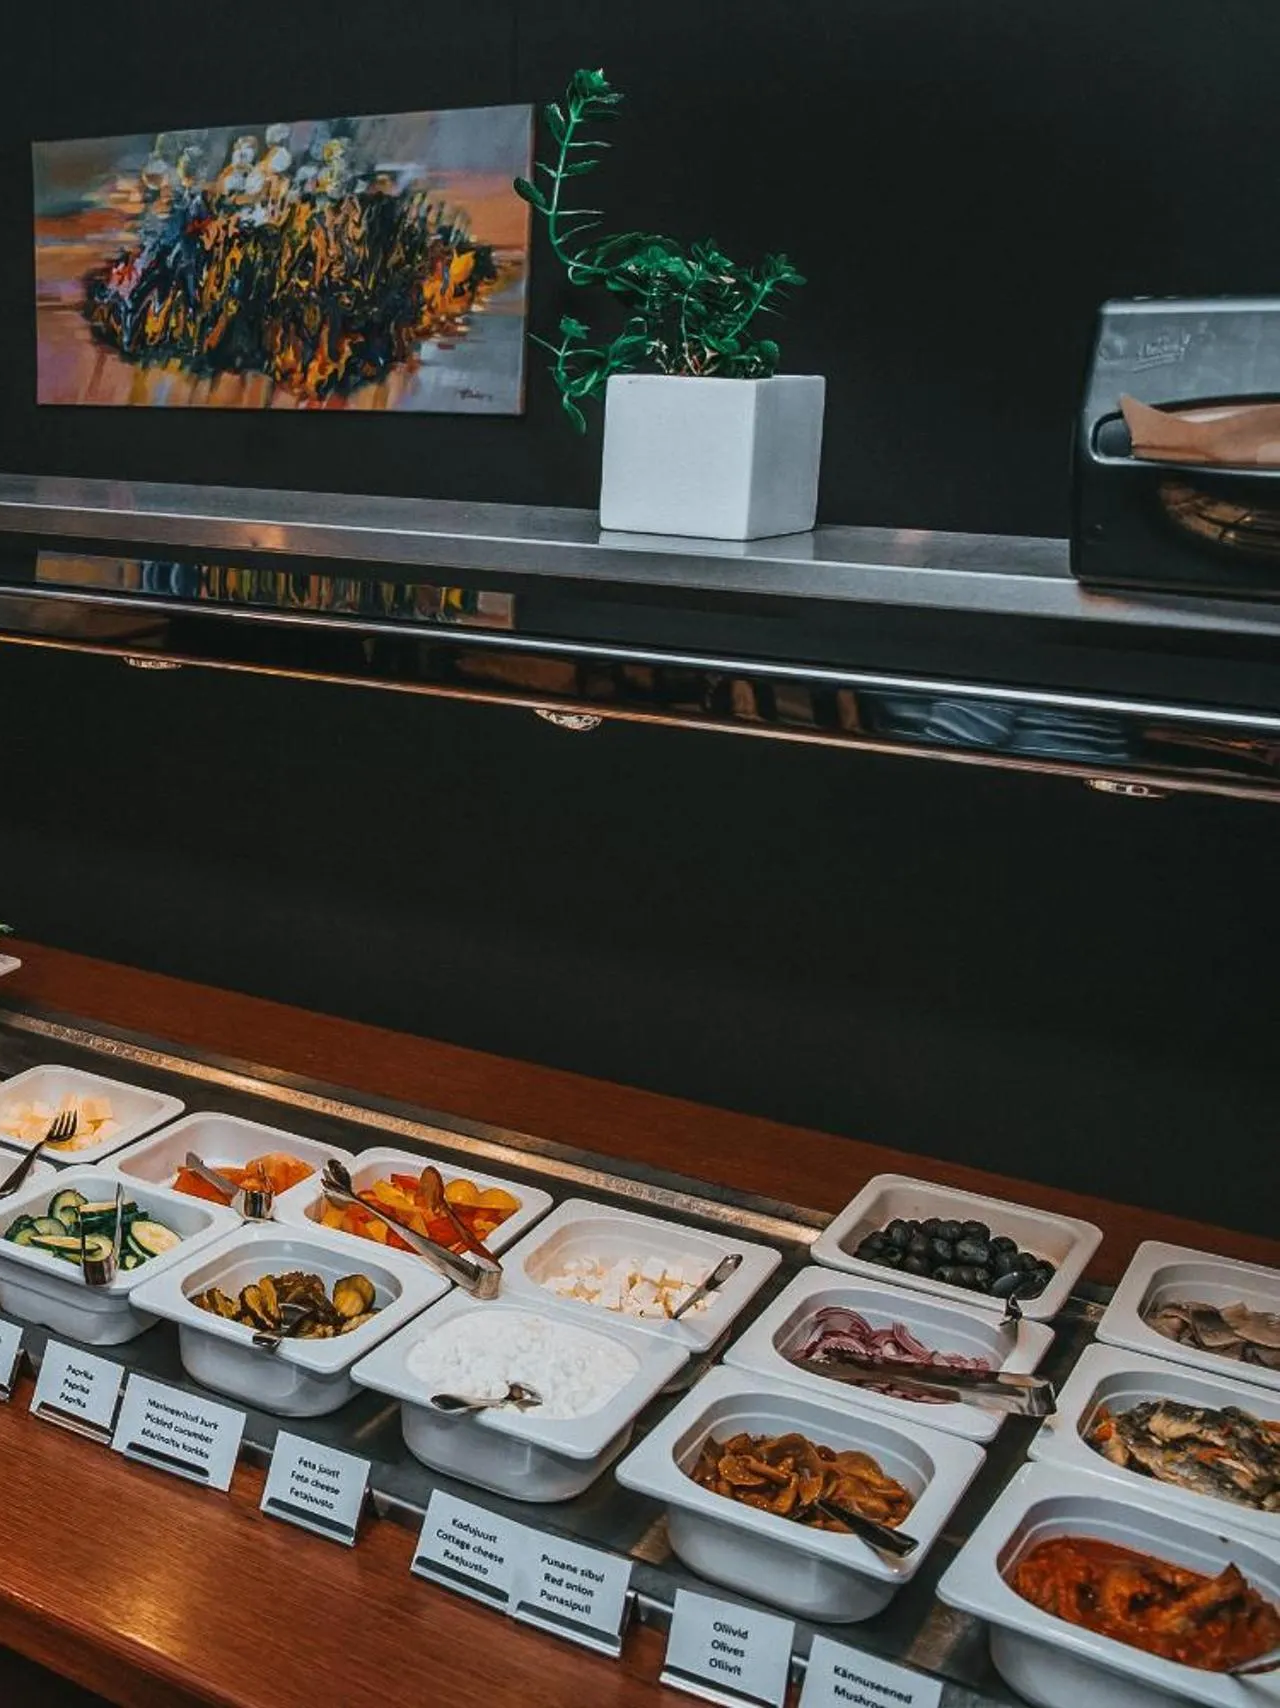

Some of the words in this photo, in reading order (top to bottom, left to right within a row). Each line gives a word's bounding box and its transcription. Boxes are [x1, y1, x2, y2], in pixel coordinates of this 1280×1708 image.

[66, 1365, 94, 1381] Paprika
[63, 1378, 90, 1394] Paprika
[59, 1392, 86, 1408] Paprika
[147, 1398, 199, 1423] Marineeritud
[145, 1412, 173, 1430] Pickled
[174, 1426, 213, 1444] cucumber
[141, 1428, 180, 1449] Marinoitu
[182, 1443, 209, 1459] kurkku
[298, 1457, 316, 1470] Feta
[317, 1464, 340, 1479] juust
[291, 1471, 309, 1483] Feta
[310, 1480, 340, 1495] cheese
[290, 1487, 334, 1509] Fetajuusto
[452, 1518, 497, 1543] Kodujuust
[437, 1529, 471, 1550] Cottage
[472, 1546, 504, 1564] cheese
[443, 1549, 488, 1575] Raejuusto
[541, 1554, 578, 1574] Punane
[580, 1569, 604, 1583] sibul
[544, 1573, 564, 1587] Red
[565, 1582, 594, 1597] onion
[540, 1589, 591, 1615] Punasipuli
[713, 1622, 748, 1640] Oliivid
[711, 1640, 745, 1658] Olives
[709, 1658, 741, 1676] Oliivit
[834, 1665, 913, 1704] Kännuseened
[834, 1685, 887, 1708] Mushro
